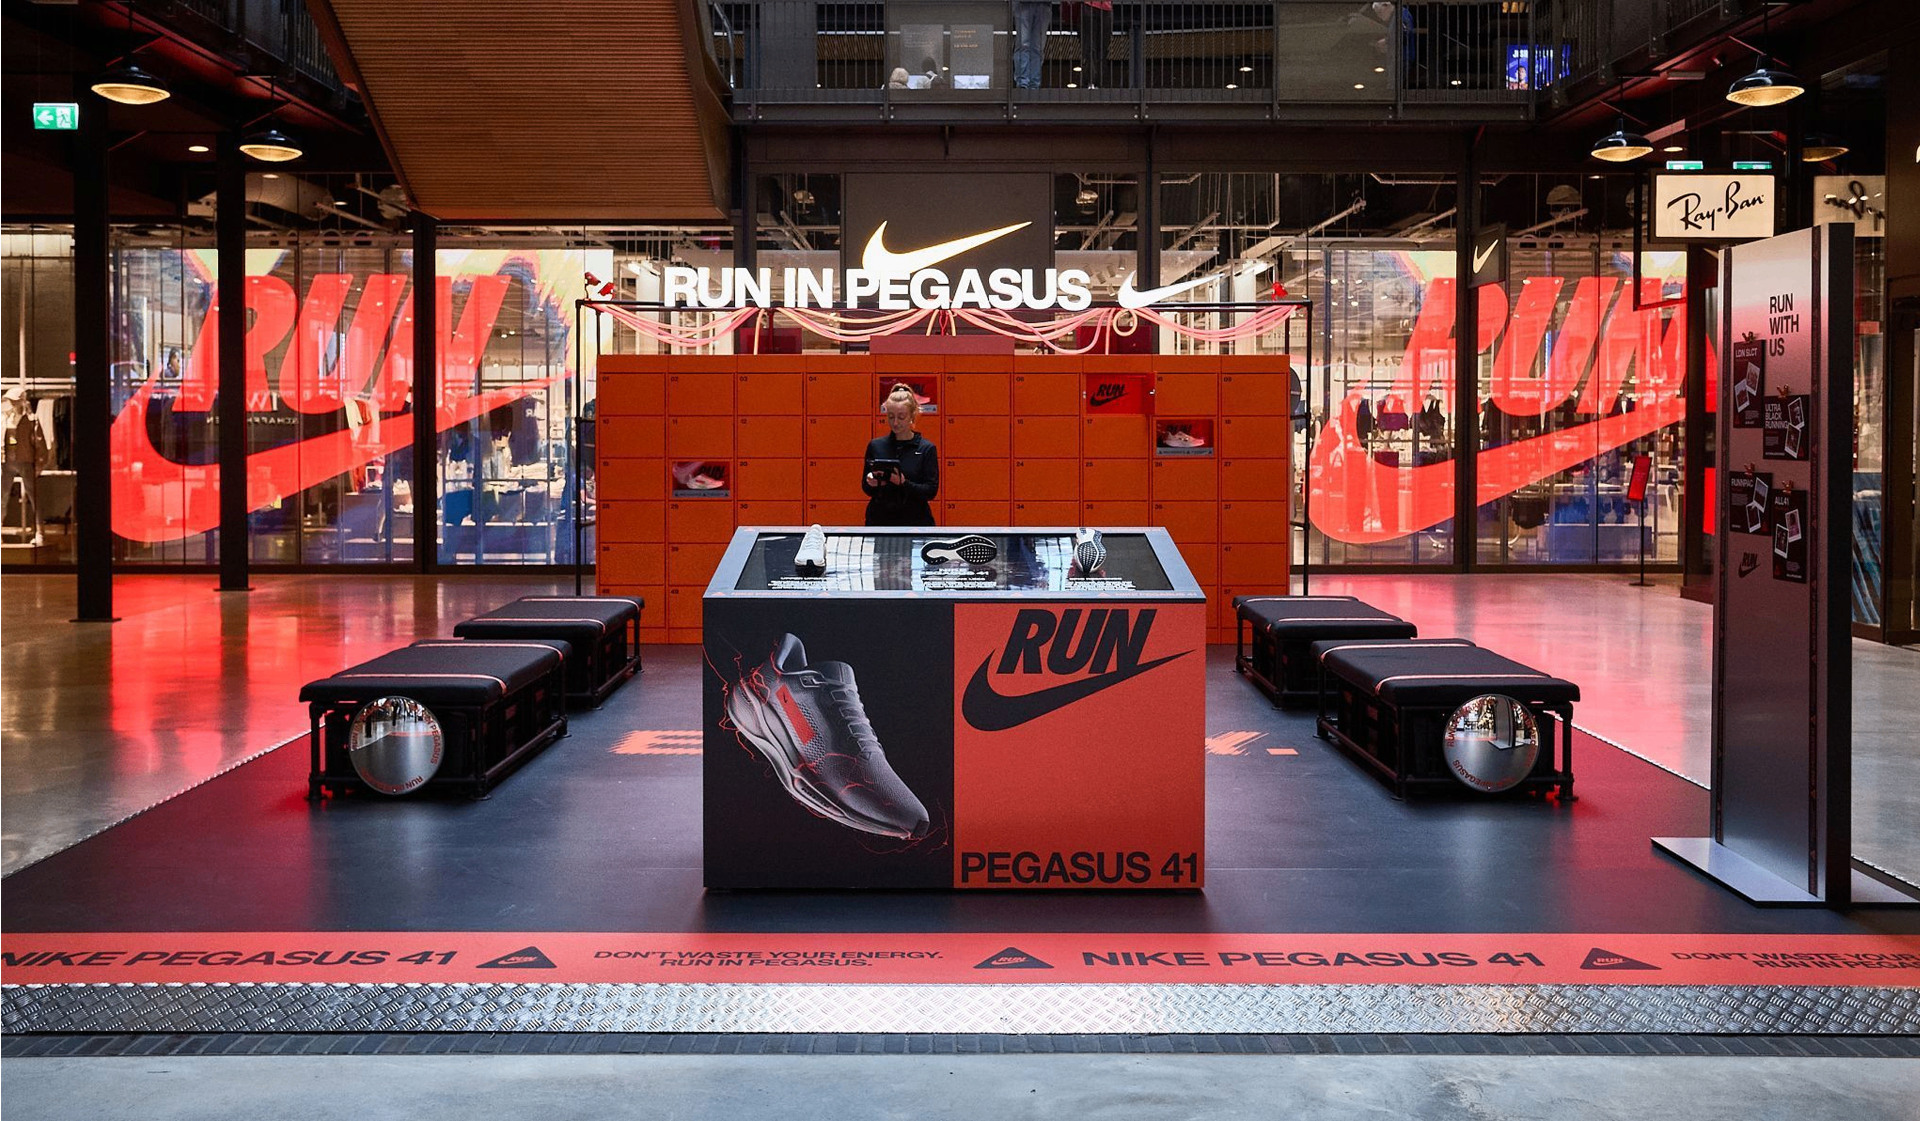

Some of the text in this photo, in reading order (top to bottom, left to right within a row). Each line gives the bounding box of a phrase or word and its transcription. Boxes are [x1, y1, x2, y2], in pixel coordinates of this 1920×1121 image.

[1668, 181, 1764, 231] Ray-Ban
[664, 266, 1092, 310] RUN IN PEGASUS
[1769, 293, 1794, 314] RUN
[1769, 314, 1799, 335] WITH
[172, 273, 512, 413] RUN
[1769, 337, 1785, 356] US
[1096, 383, 1126, 397] RUN
[1765, 403, 1781, 412] ULTRA
[1765, 412, 1783, 420] BLACK
[995, 608, 1159, 675] RUN
[961, 851, 1198, 884] PEGASUS 41
[0, 951, 458, 967] NIKE PEGASUS 41
[594, 950, 944, 960] DON'T WASTE YOUR ENERGY.
[660, 958, 873, 967] RUN IN PEGASUS.
[1081, 951, 1546, 967] NIKE PEGASUS 41
[1671, 952, 1748, 960] DON'T
[1751, 952, 1844, 961] WASTE
[1752, 960, 1811, 969] RUN
[1813, 960, 1843, 969] IN
